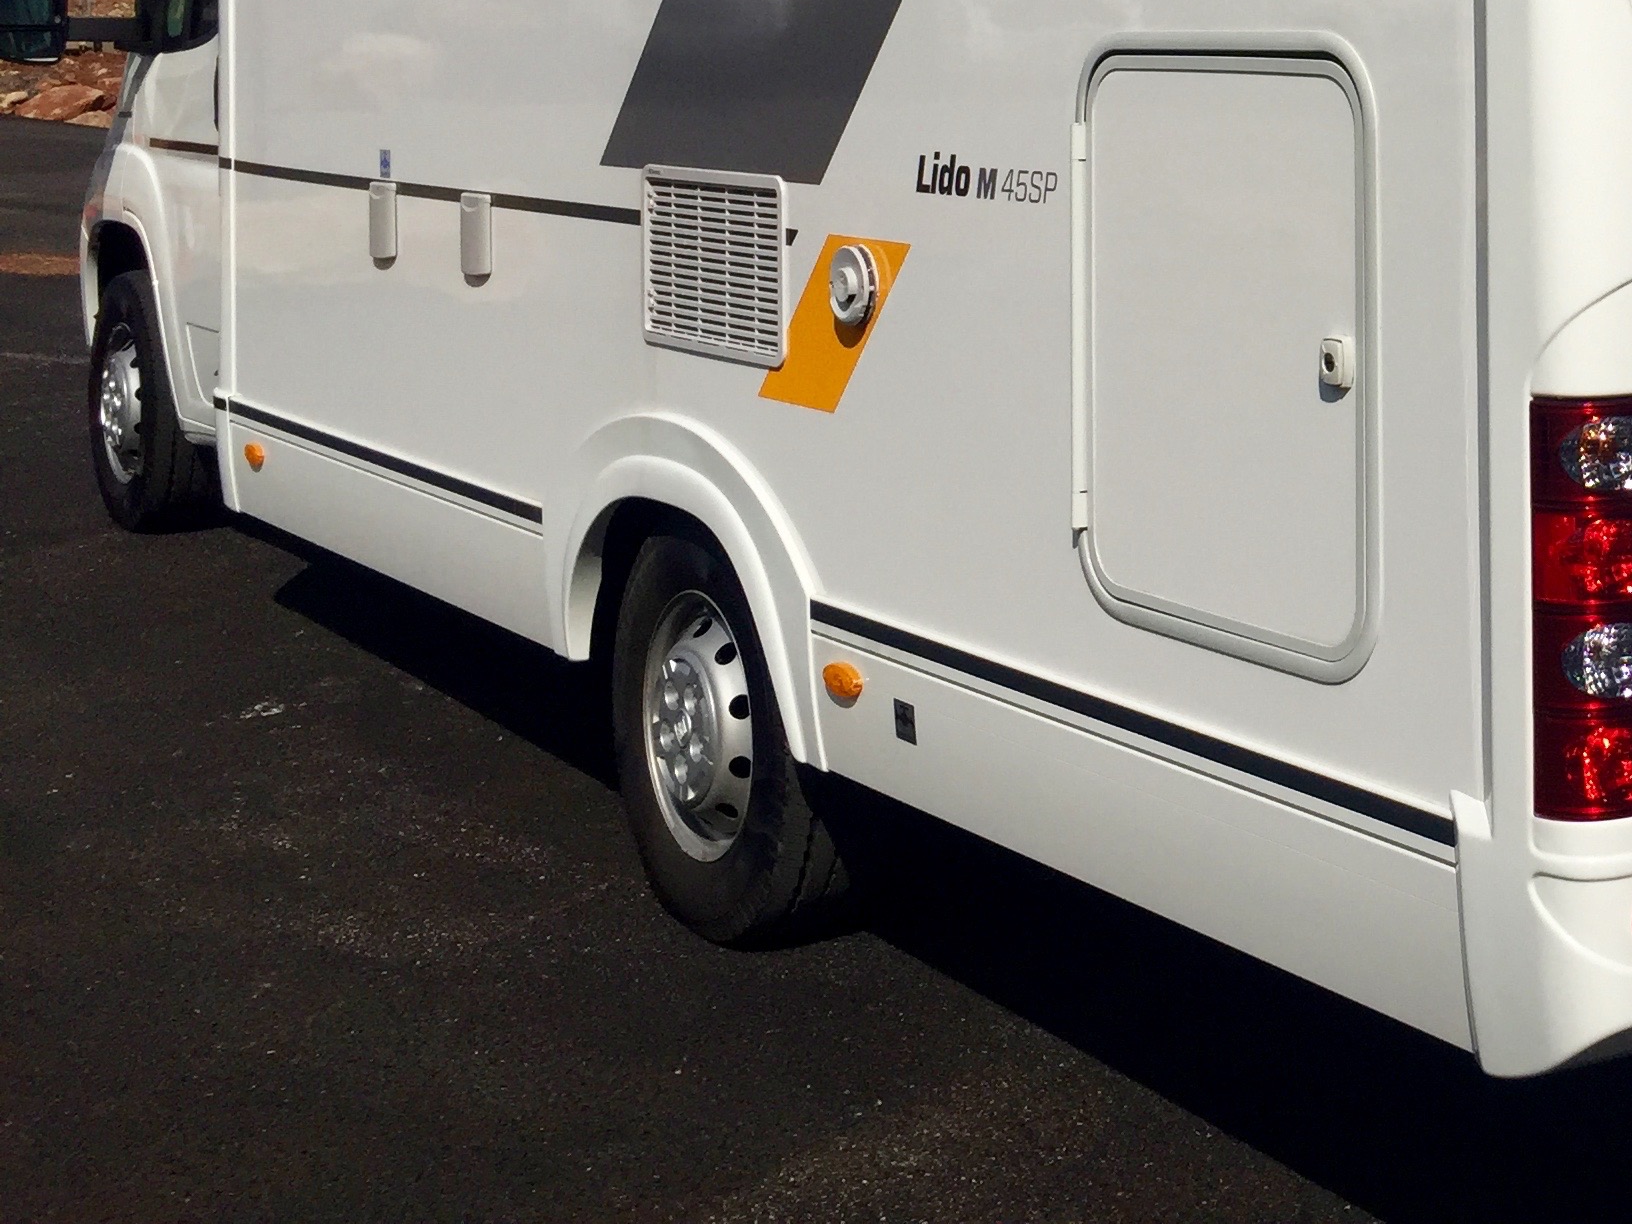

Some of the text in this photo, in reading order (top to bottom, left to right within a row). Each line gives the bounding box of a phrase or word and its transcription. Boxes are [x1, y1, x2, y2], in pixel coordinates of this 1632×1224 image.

[915, 151, 1058, 204] Lido M 45SP
